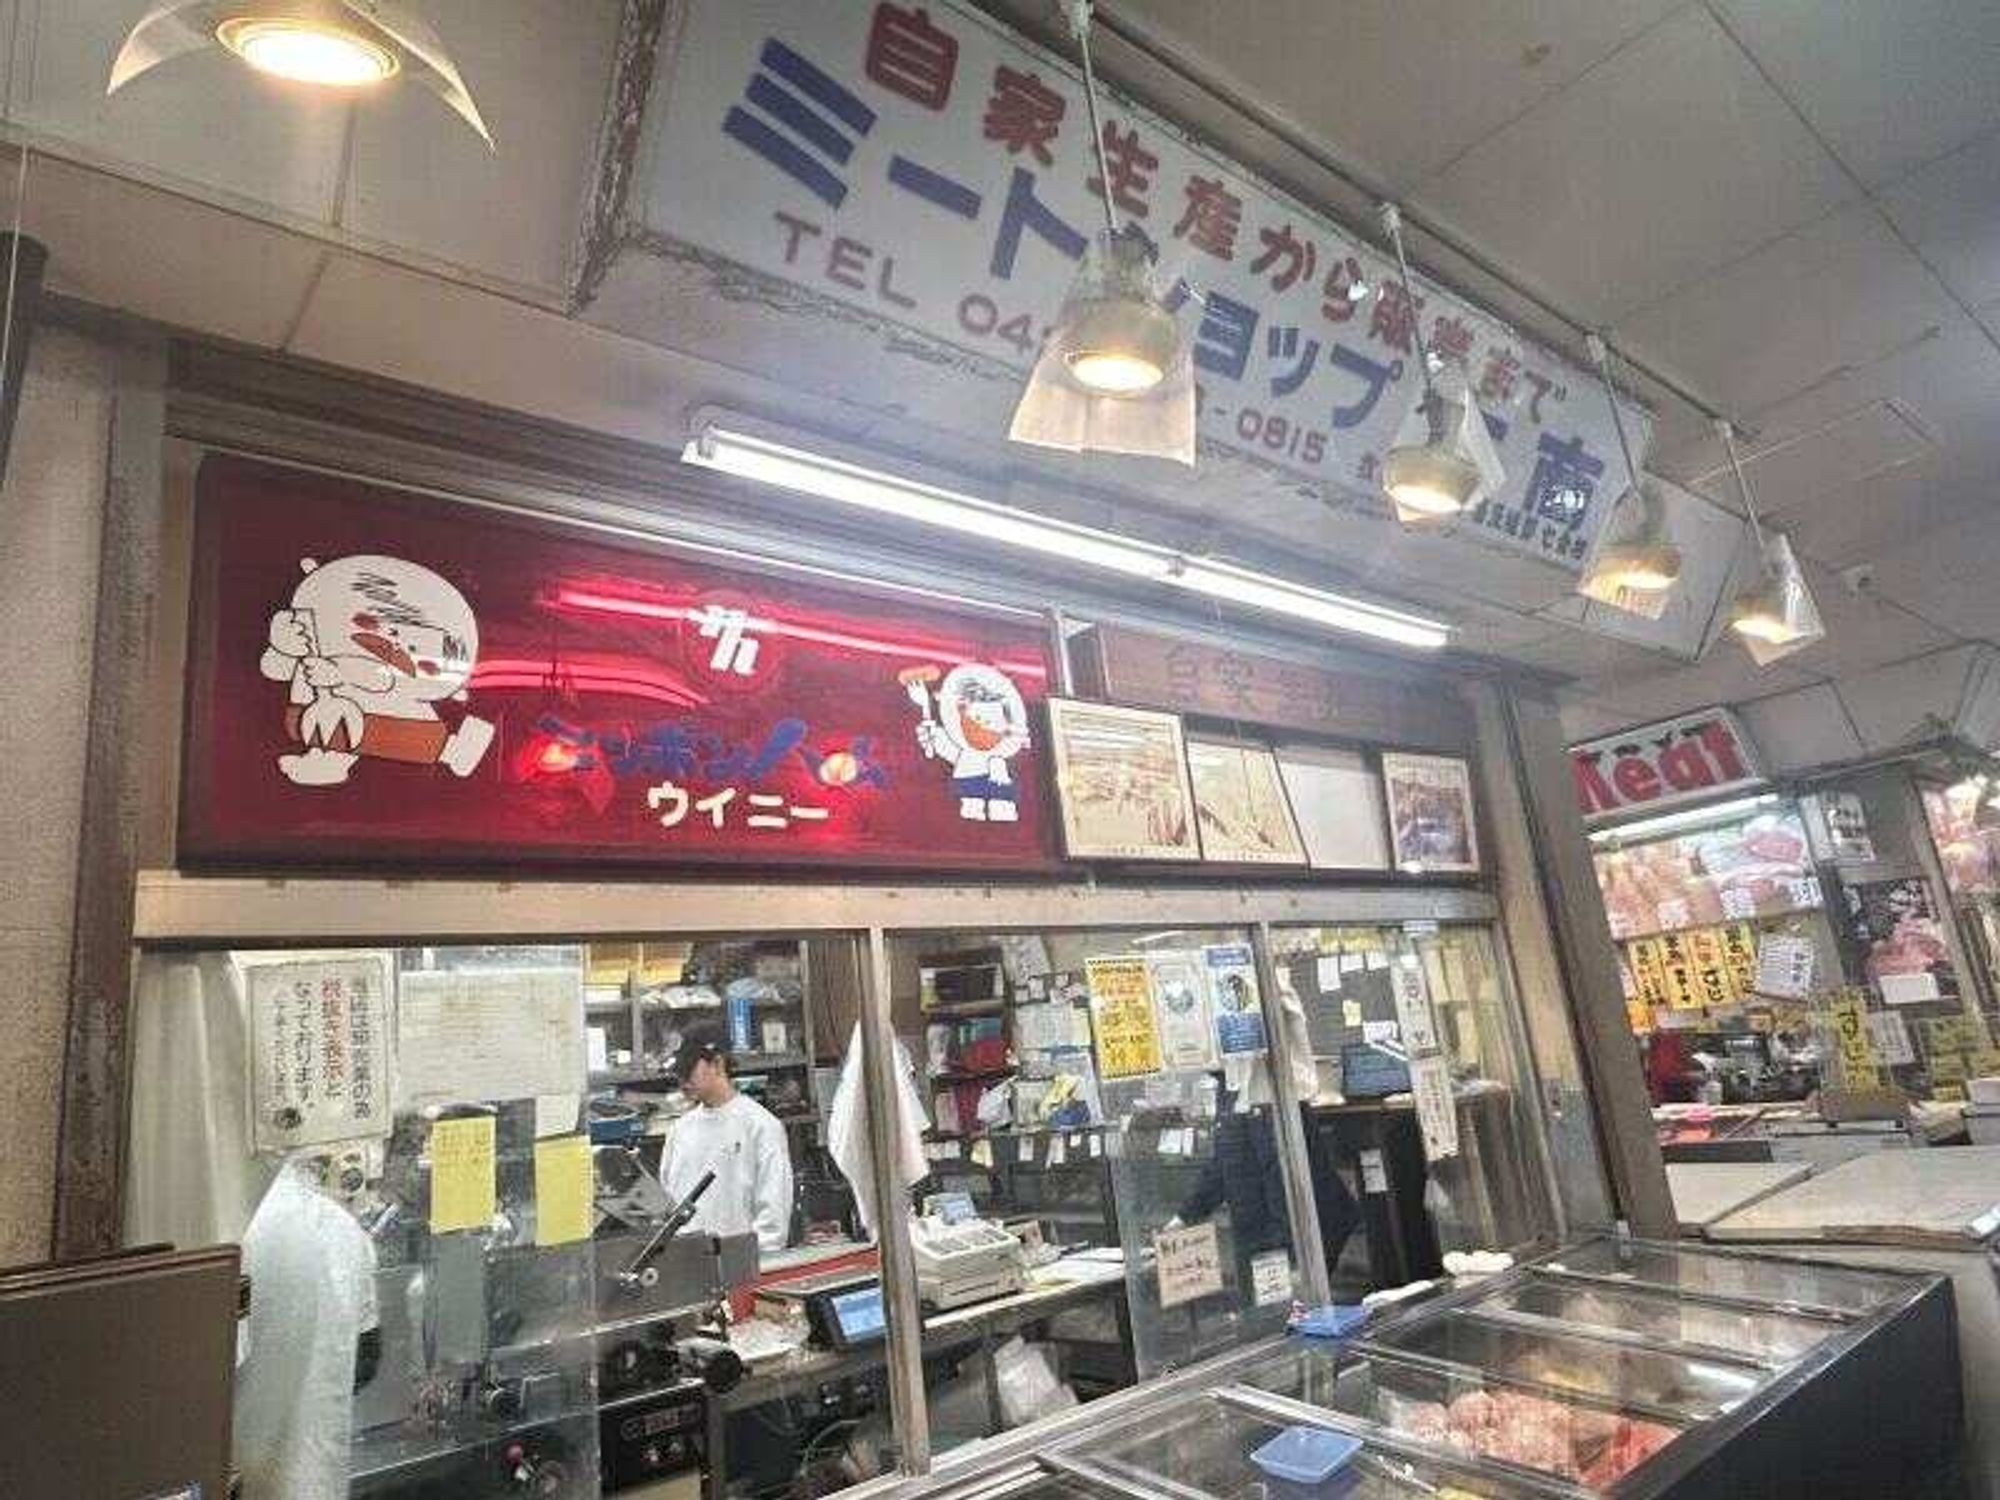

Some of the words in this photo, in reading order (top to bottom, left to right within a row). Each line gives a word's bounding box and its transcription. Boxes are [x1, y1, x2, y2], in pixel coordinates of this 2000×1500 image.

[773, 210, 917, 309] TEL
[647, 780, 830, 829] ウイニー
